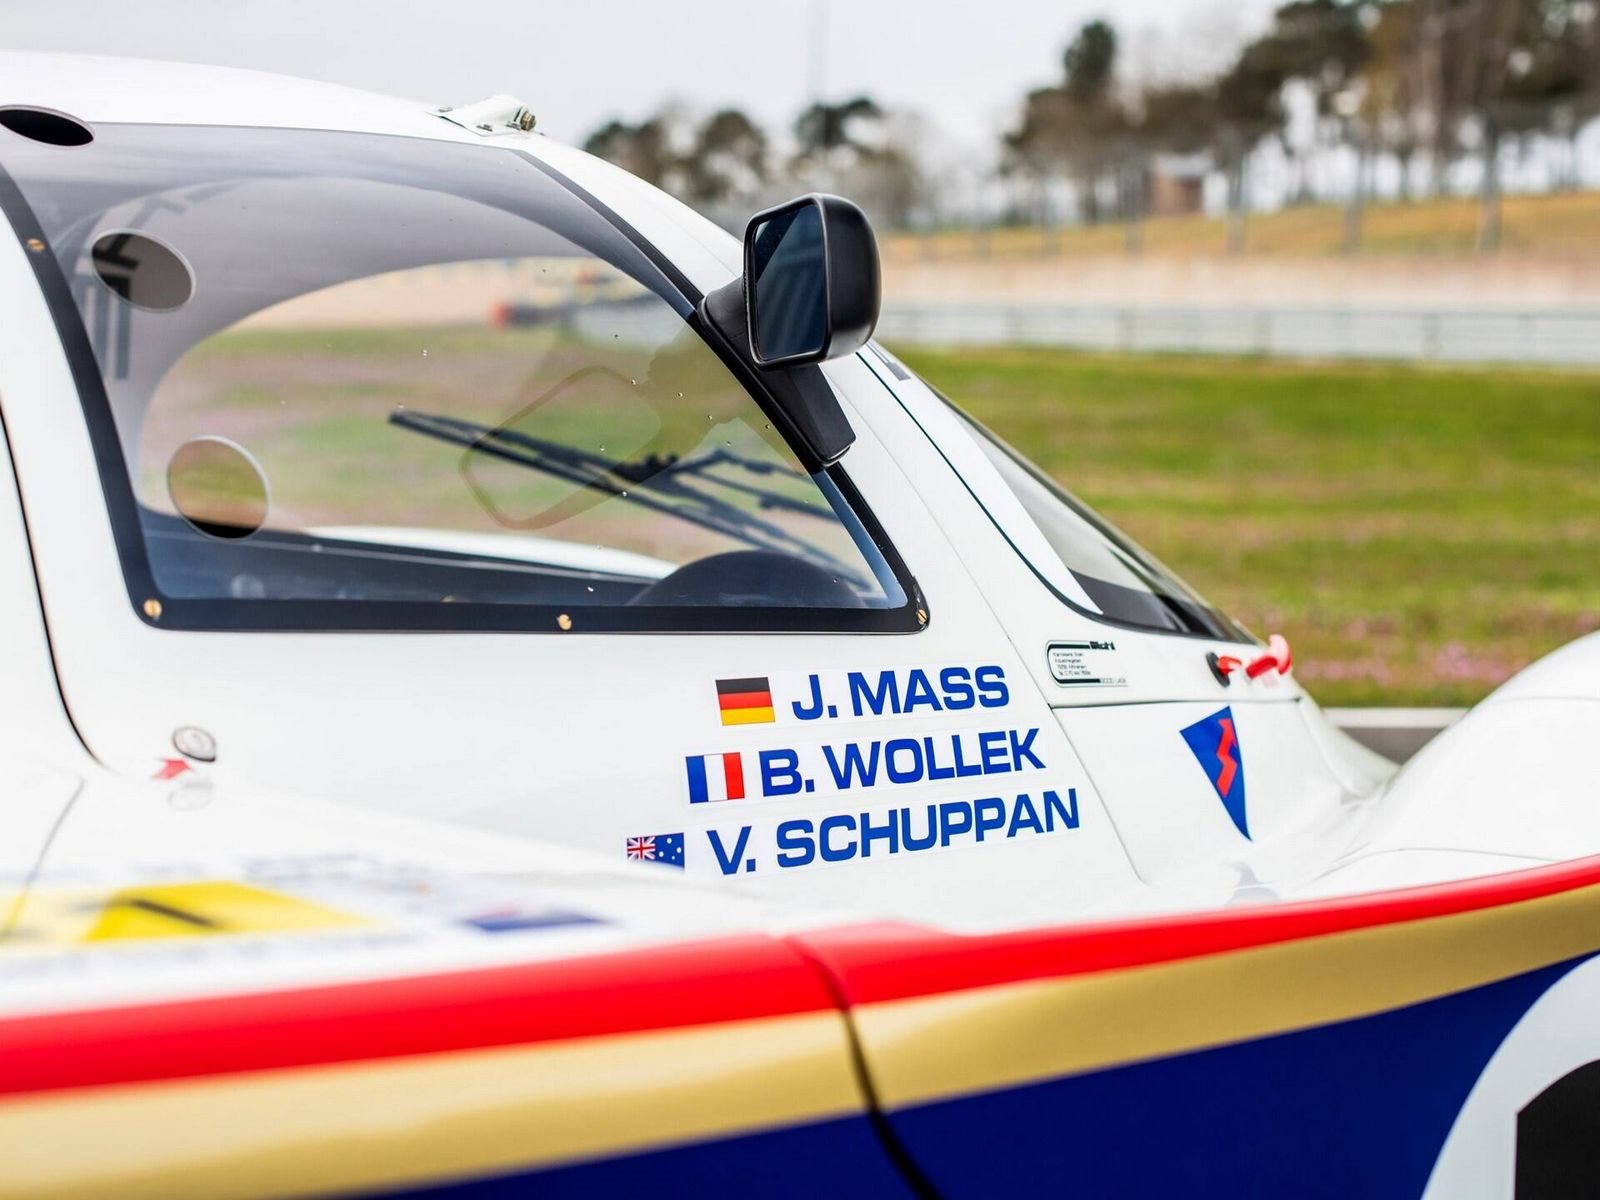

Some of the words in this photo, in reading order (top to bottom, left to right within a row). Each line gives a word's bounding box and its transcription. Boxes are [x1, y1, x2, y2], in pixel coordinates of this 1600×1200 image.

[792, 674, 838, 721] J.
[848, 665, 1010, 717] MASS
[759, 748, 815, 798] B.
[823, 728, 1046, 791] WOLLEK
[707, 825, 757, 876] V.
[776, 788, 1081, 869] SCHUPPAN
